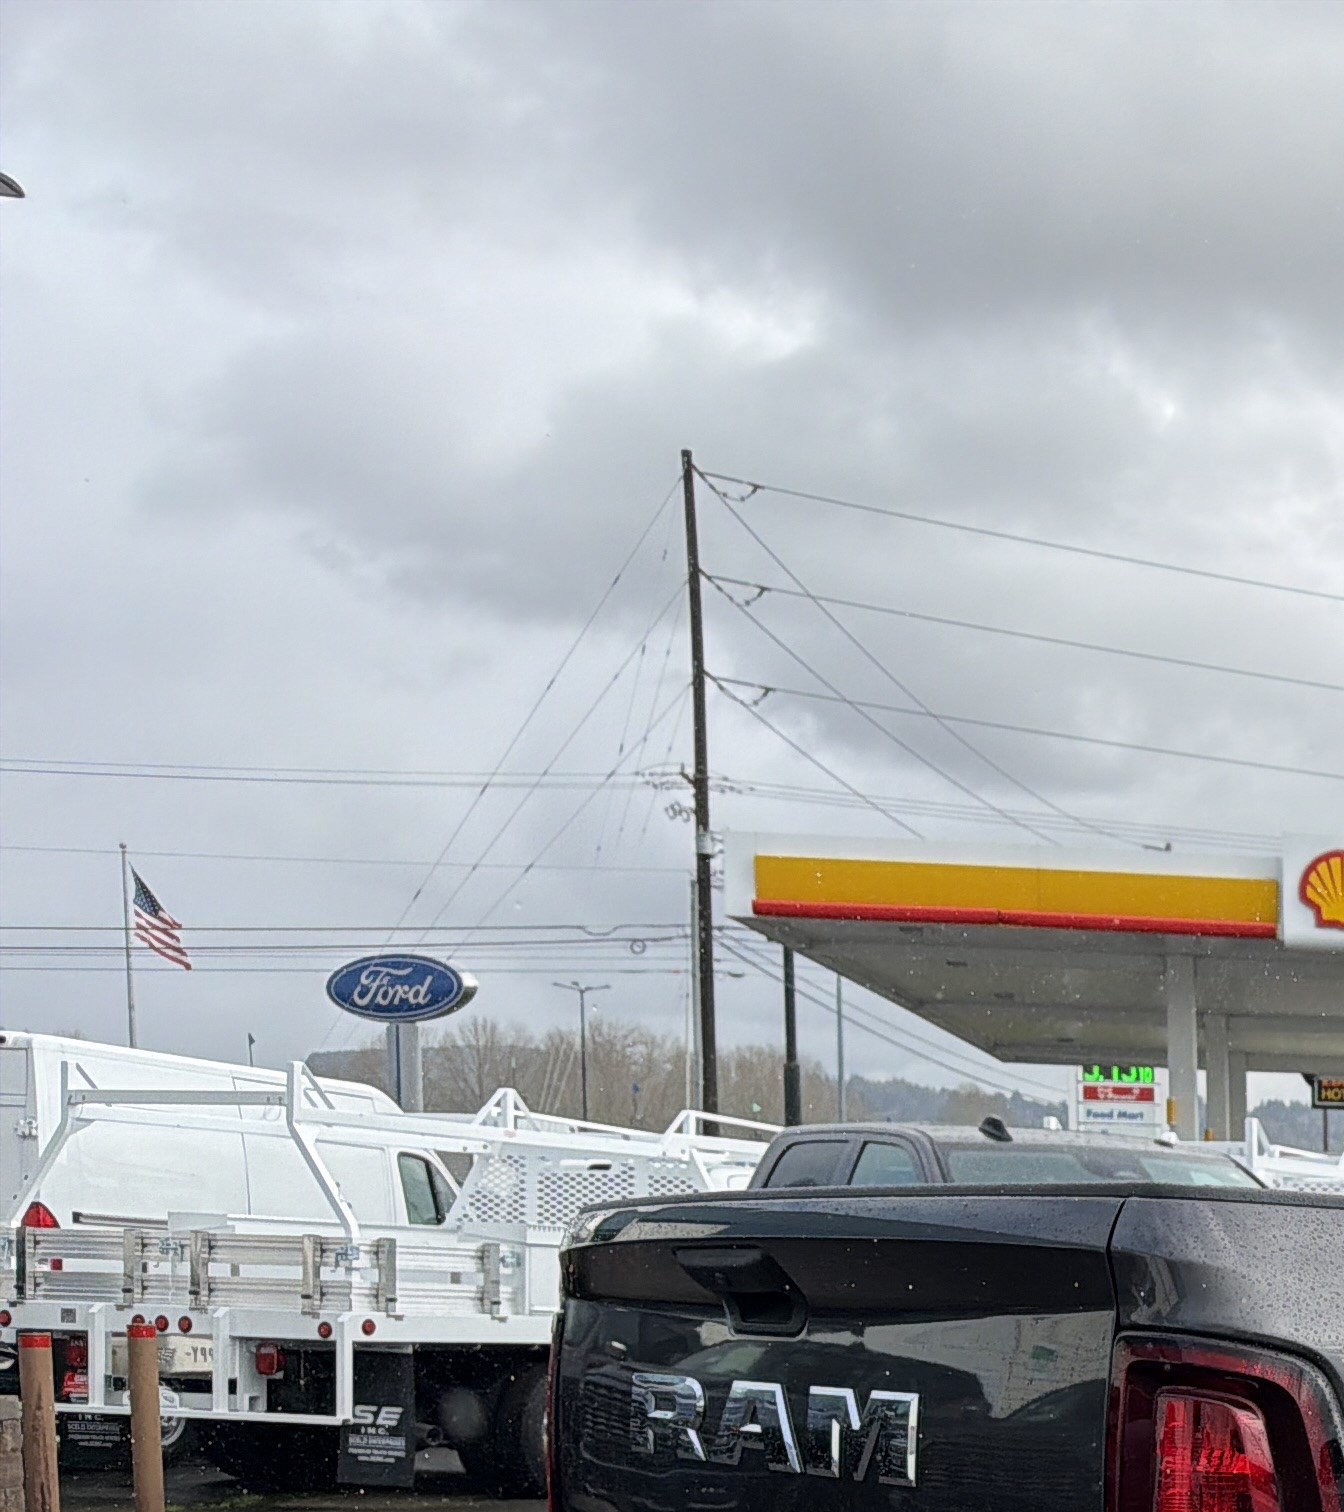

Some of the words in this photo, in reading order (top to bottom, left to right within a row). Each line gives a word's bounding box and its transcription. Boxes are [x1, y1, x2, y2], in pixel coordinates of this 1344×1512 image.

[352, 966, 433, 1007] Ford
[354, 1404, 404, 1427] SE
[630, 1371, 920, 1488] RAM
